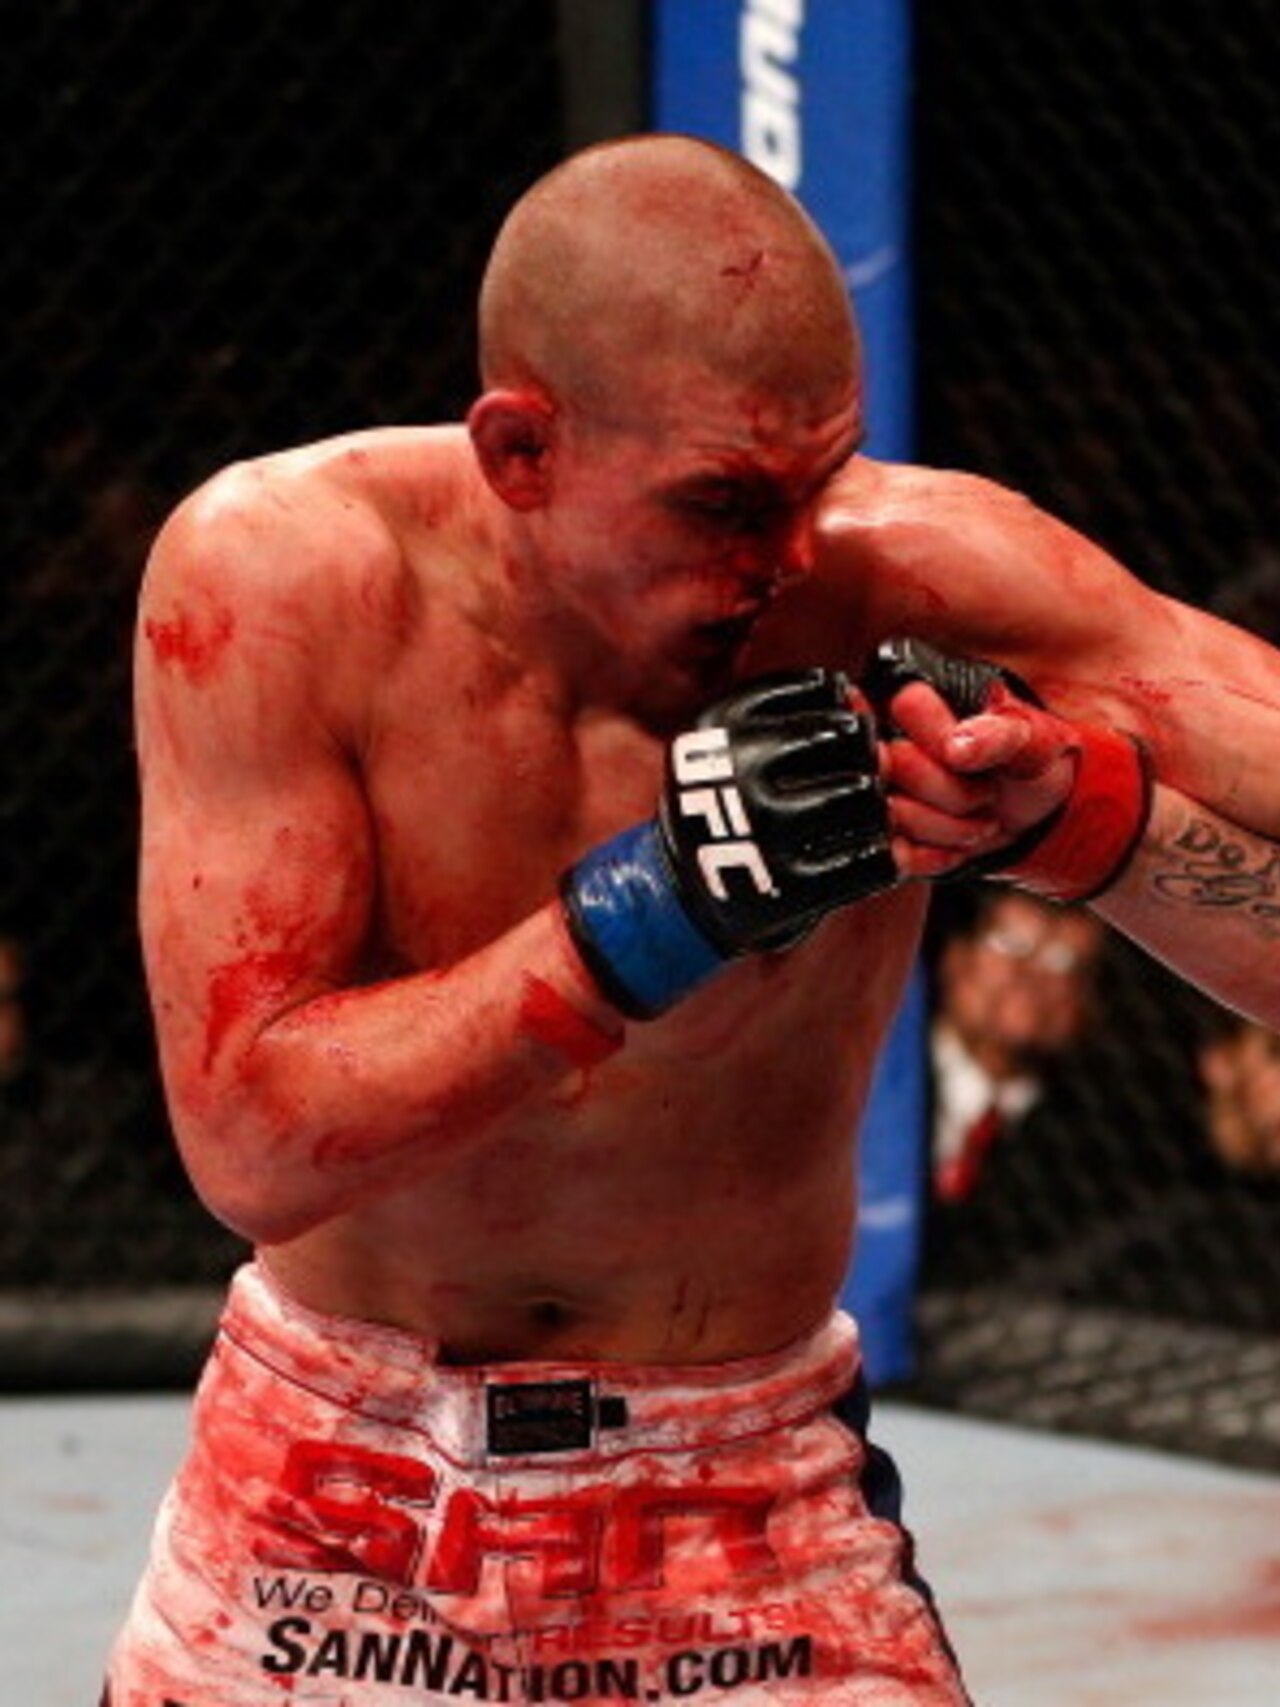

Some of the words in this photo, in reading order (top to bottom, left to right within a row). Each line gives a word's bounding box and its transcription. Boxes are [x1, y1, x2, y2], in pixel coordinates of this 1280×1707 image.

[672, 727, 774, 900] UFC
[1174, 821, 1247, 867] Do
[253, 1577, 333, 1614] We
